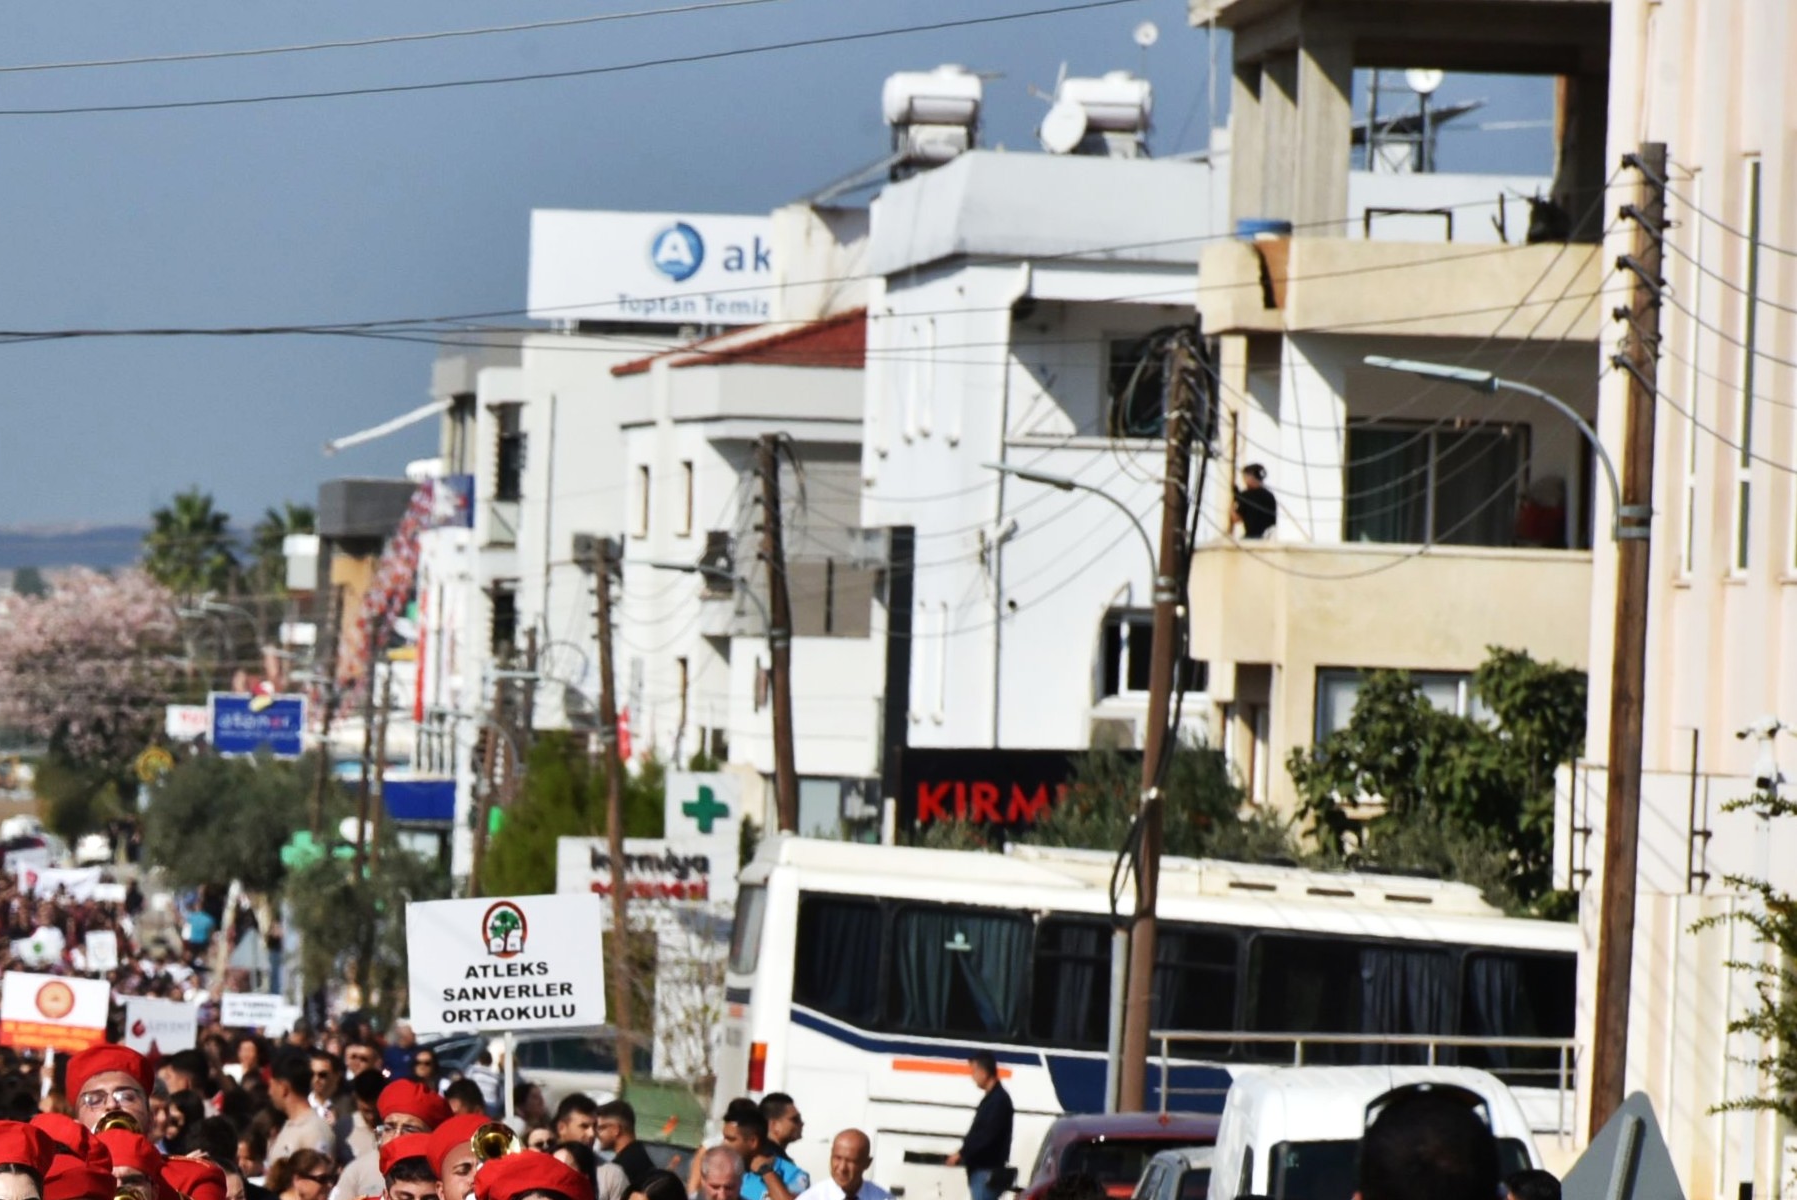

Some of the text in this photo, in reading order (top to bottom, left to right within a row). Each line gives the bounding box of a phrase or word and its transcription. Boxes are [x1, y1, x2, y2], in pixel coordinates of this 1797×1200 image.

[618, 293, 770, 316] Toptan Temiz
[465, 961, 549, 980] ATLEKS
[443, 982, 574, 1002] SANVERLER
[442, 1004, 576, 1024] ORTAOKULU
